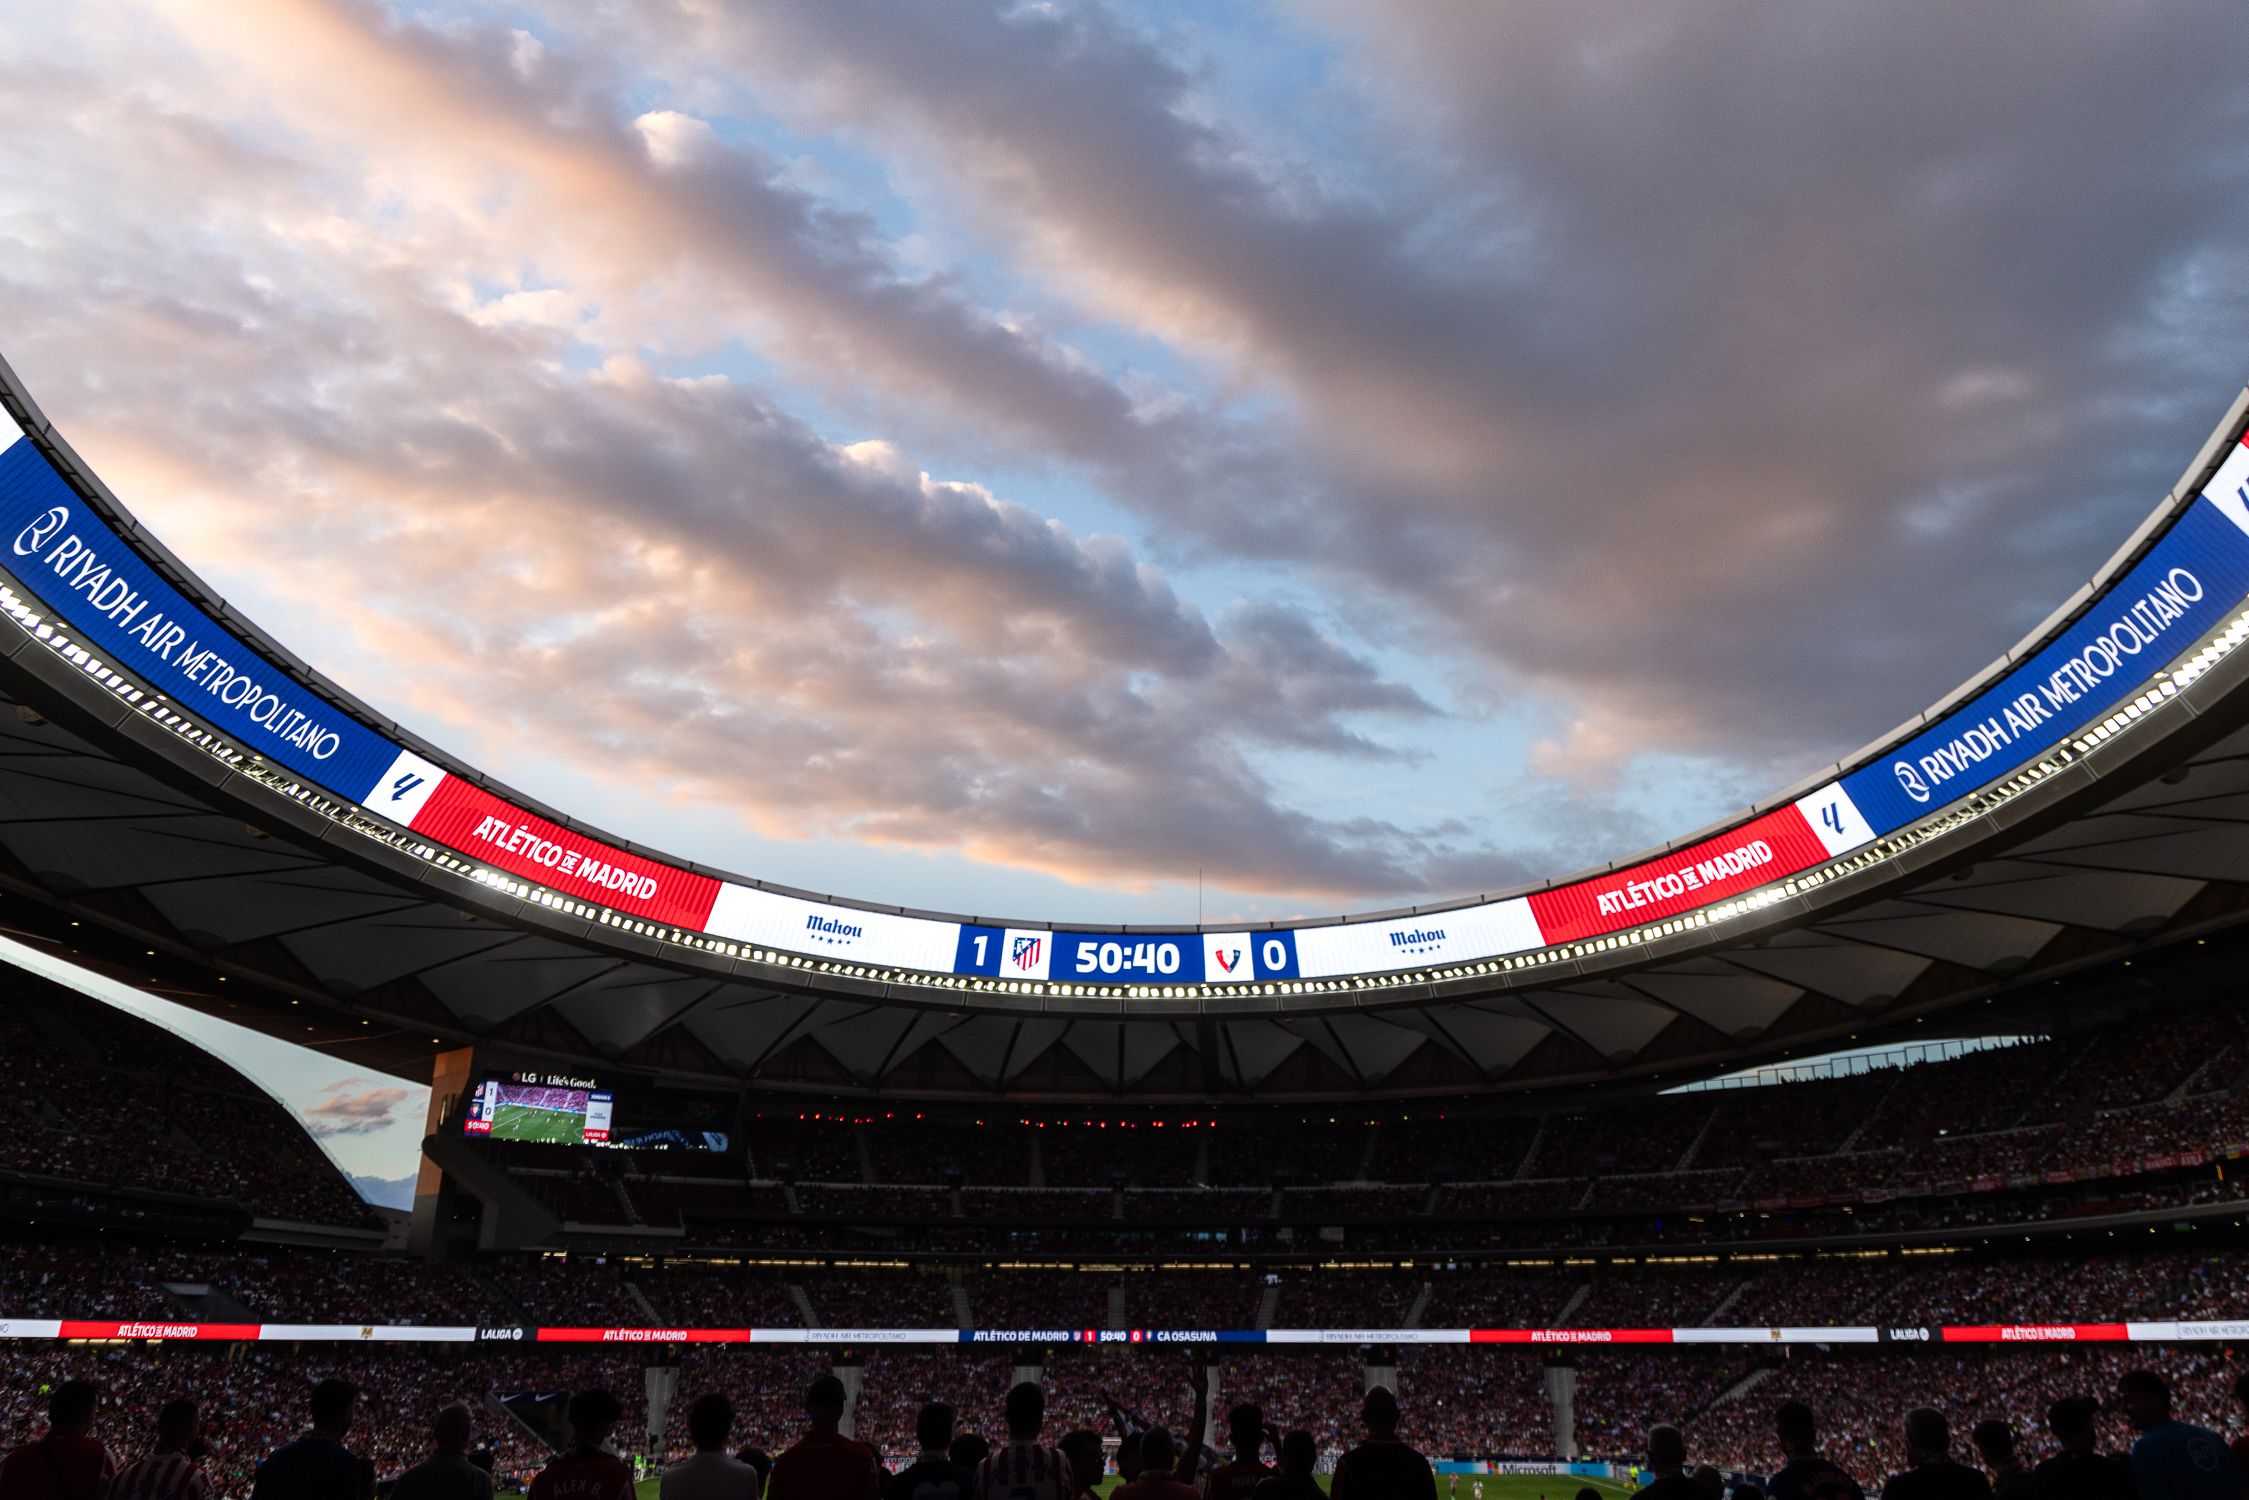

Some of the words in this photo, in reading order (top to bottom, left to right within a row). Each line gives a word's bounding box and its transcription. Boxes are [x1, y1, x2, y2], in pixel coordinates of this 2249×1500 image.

[44, 535, 140, 625] RIYADH
[129, 613, 185, 659] AIR
[173, 640, 340, 760] METROPOLITANO
[1919, 718, 2012, 786] RIYADH
[2002, 694, 2052, 739] AIR
[2038, 567, 2204, 711] METROPOLITANO
[472, 815, 563, 867] ATLÉTICO
[558, 850, 580, 874] DE
[575, 856, 658, 901] MADRID
[1596, 873, 1685, 917] ATLÉTICO
[1678, 867, 1704, 891] DE
[1700, 840, 1774, 885] MADRID
[806, 914, 862, 939] Mahou
[1389, 926, 1446, 949] Mahou
[973, 935, 986, 967] 1
[1263, 940, 1287, 971] 0
[1076, 942, 1180, 975] 50:40
[521, 1072, 537, 1083] LG
[547, 1075, 569, 1087] Life's
[488, 1088, 494, 1097] 1
[484, 1107, 491, 1116] 0
[467, 1121, 490, 1130] 50:40
[117, 1322, 156, 1337] ATLÉTICO
[163, 1325, 198, 1337] MADRID
[481, 1328, 511, 1340] LALIGA
[603, 1328, 643, 1341] ATLÉTICO
[651, 1331, 687, 1341] MADRID
[973, 1329, 1017, 1342] ATLÉTICO
[1018, 1331, 1030, 1342] DE
[1031, 1331, 1069, 1342] MADRID
[1087, 1331, 1092, 1341] 1
[1100, 1331, 1126, 1341] 50:40
[1133, 1331, 1140, 1341] 0
[1157, 1331, 1170, 1341] CA
[1172, 1331, 1217, 1341] OSASUNA
[1531, 1329, 1569, 1341] ATLÉTICO
[1578, 1331, 1612, 1341] MADRID
[1890, 1328, 1919, 1340] LALIGA
[2001, 1325, 2037, 1339] ATLÉTICO
[2044, 1327, 2076, 1339] MADRID
[1502, 1464, 1557, 1476] Microsoft
